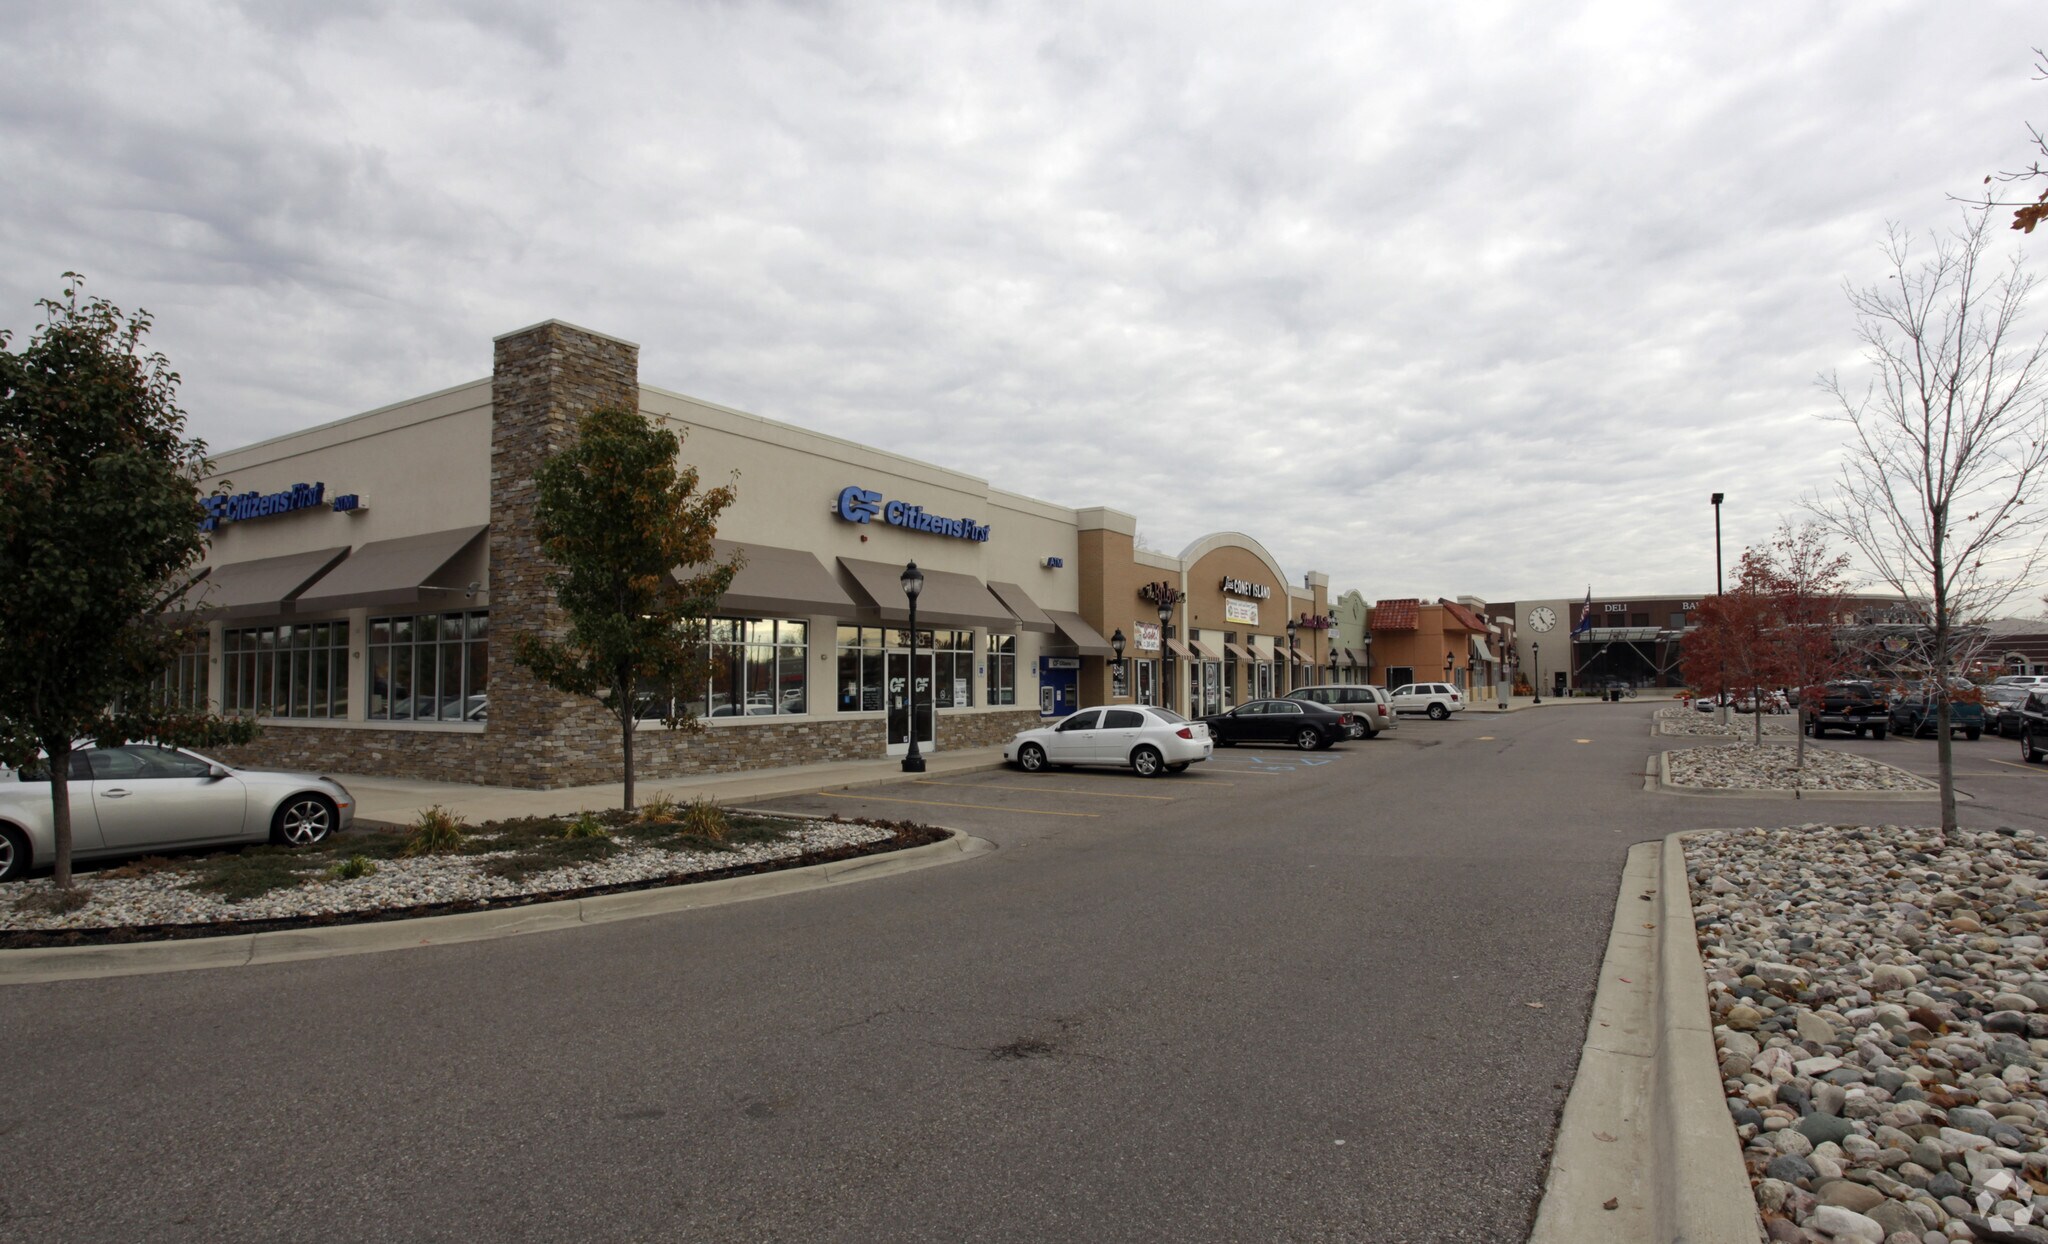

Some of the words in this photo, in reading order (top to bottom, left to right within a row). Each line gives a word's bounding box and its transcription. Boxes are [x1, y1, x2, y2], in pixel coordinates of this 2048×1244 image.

[333, 495, 358, 512] ATM
[838, 486, 882, 524] CF
[1047, 556, 1063, 569] ATM
[1234, 579, 1251, 596] CONEY
[1252, 583, 1271, 599] ISLAND
[1605, 603, 1627, 612] DELI
[890, 677, 906, 693] CF
